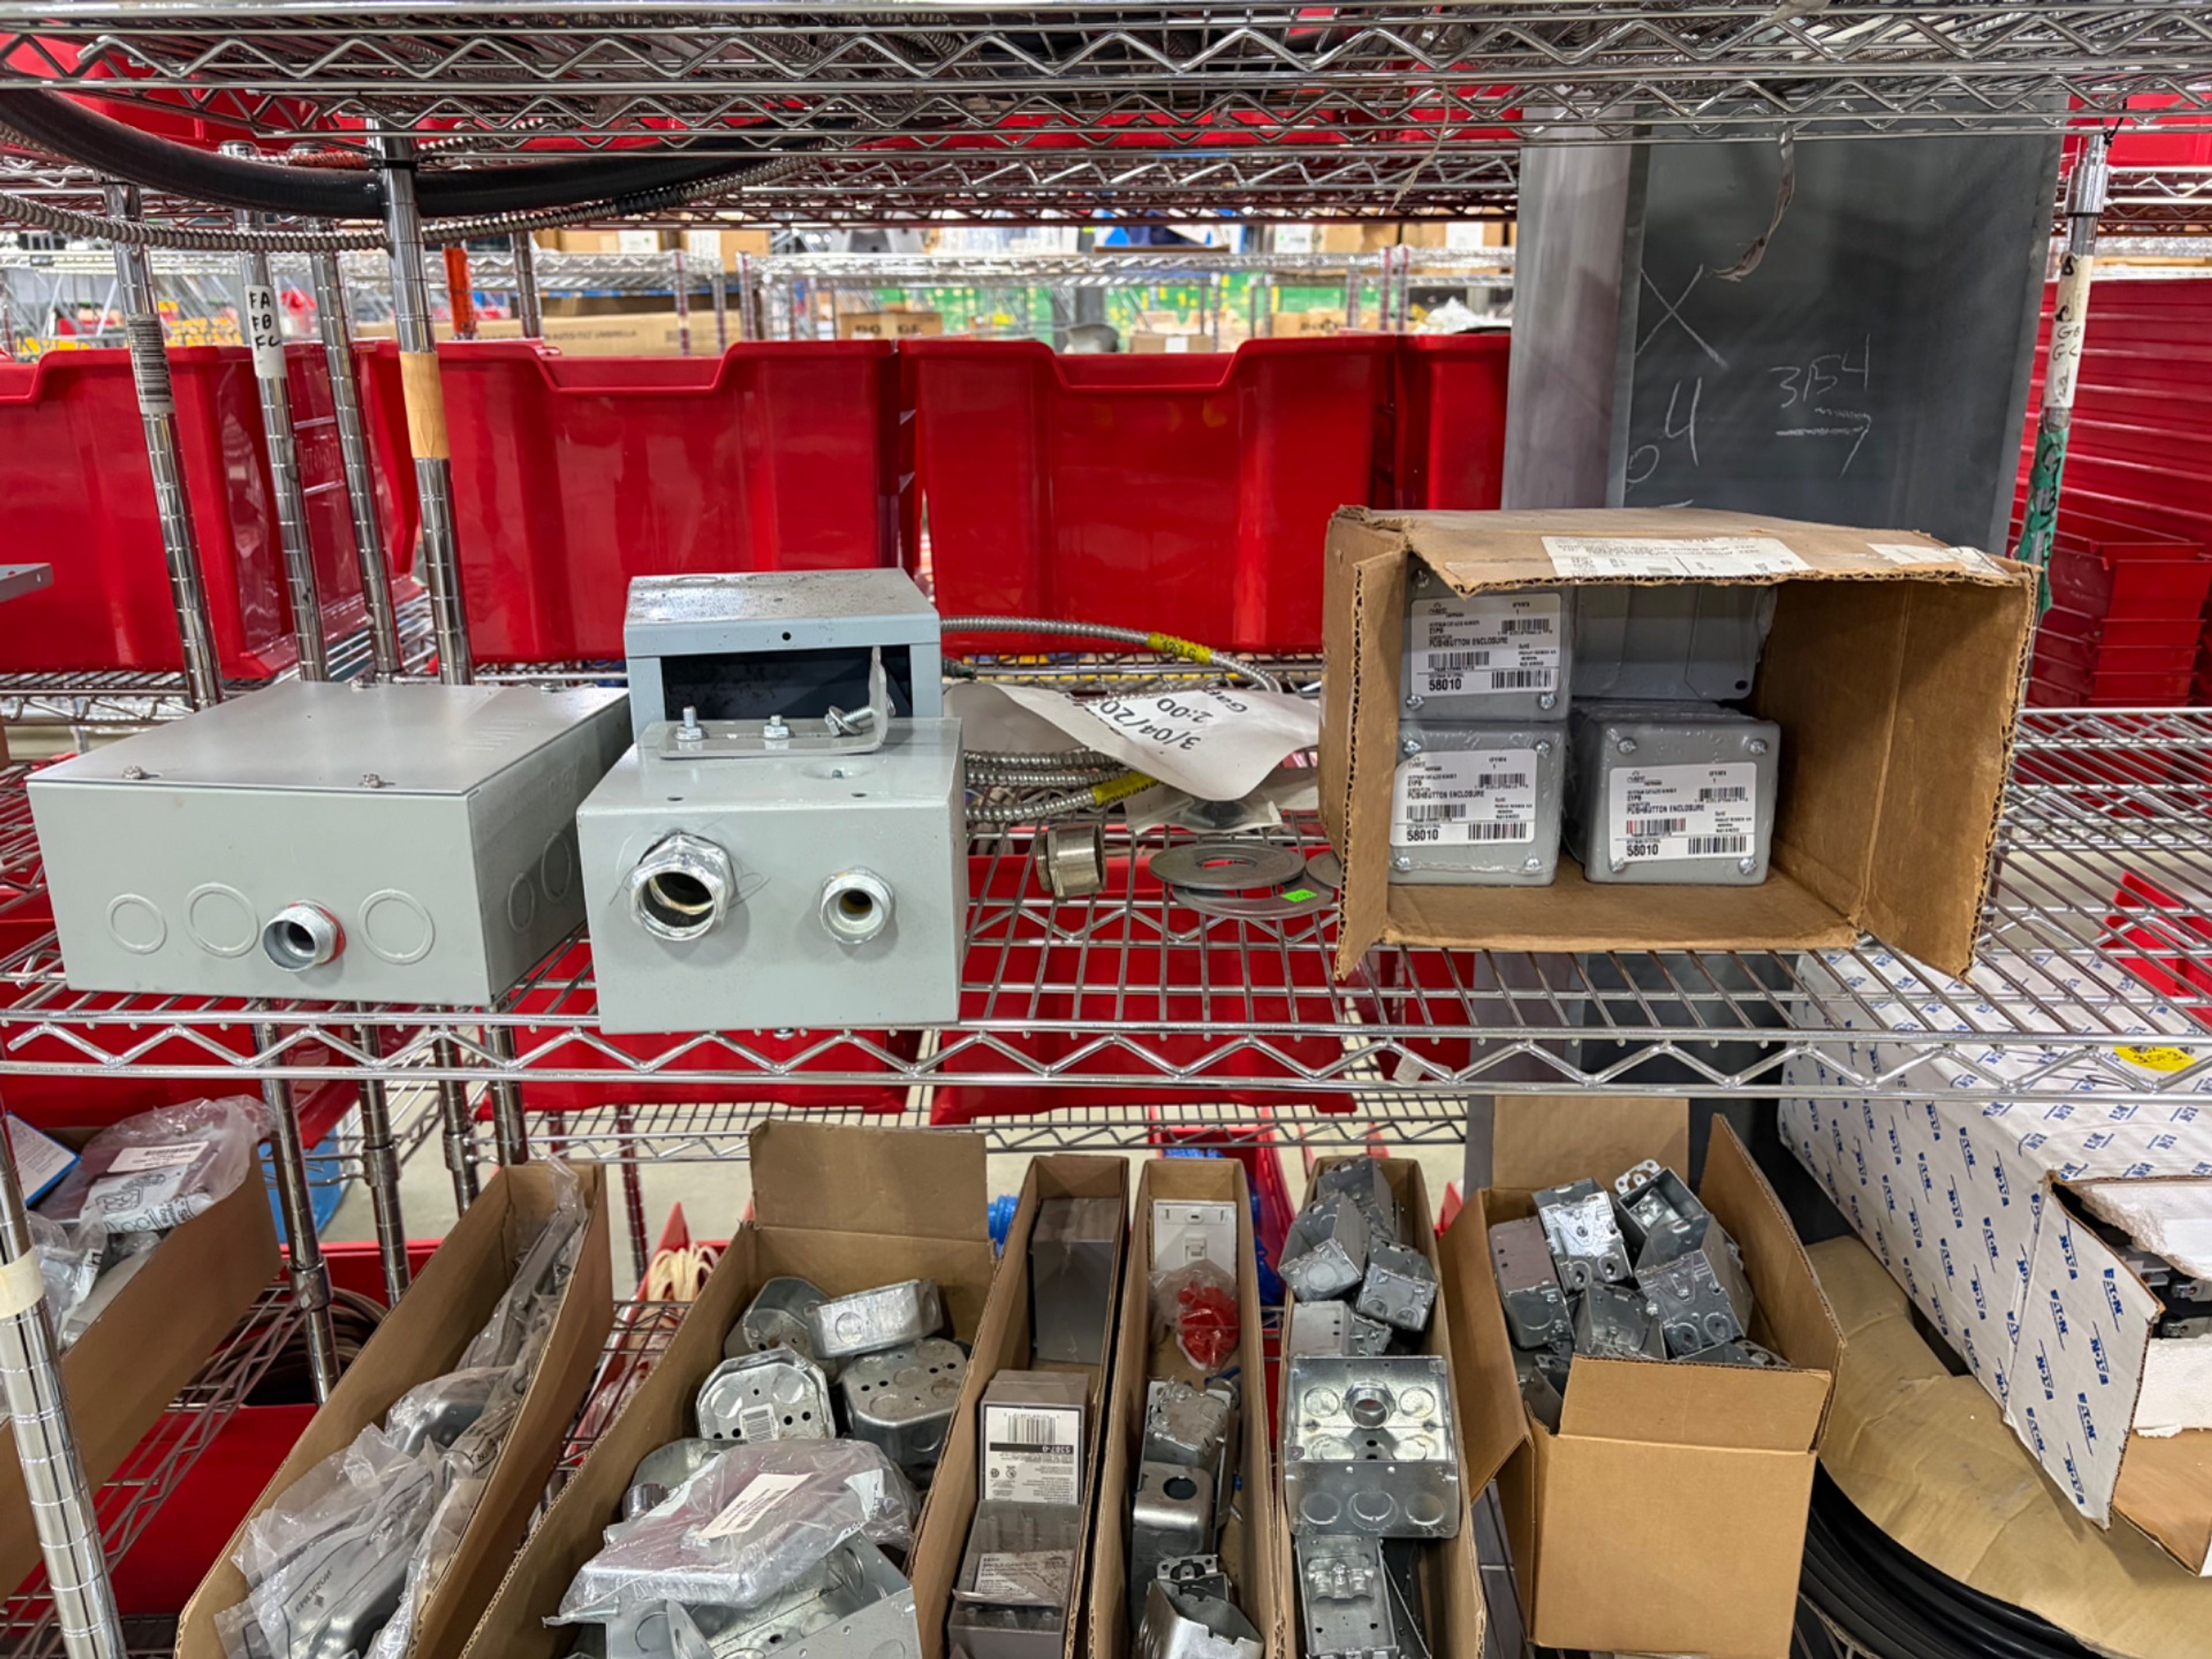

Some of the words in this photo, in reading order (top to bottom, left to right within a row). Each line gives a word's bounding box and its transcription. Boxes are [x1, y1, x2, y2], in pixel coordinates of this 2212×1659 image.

[1429, 678, 1461, 691] 58010
[1157, 698, 1213, 723] 2:00
[1407, 828, 1438, 841] 58010
[1627, 844, 1658, 856] 58010
